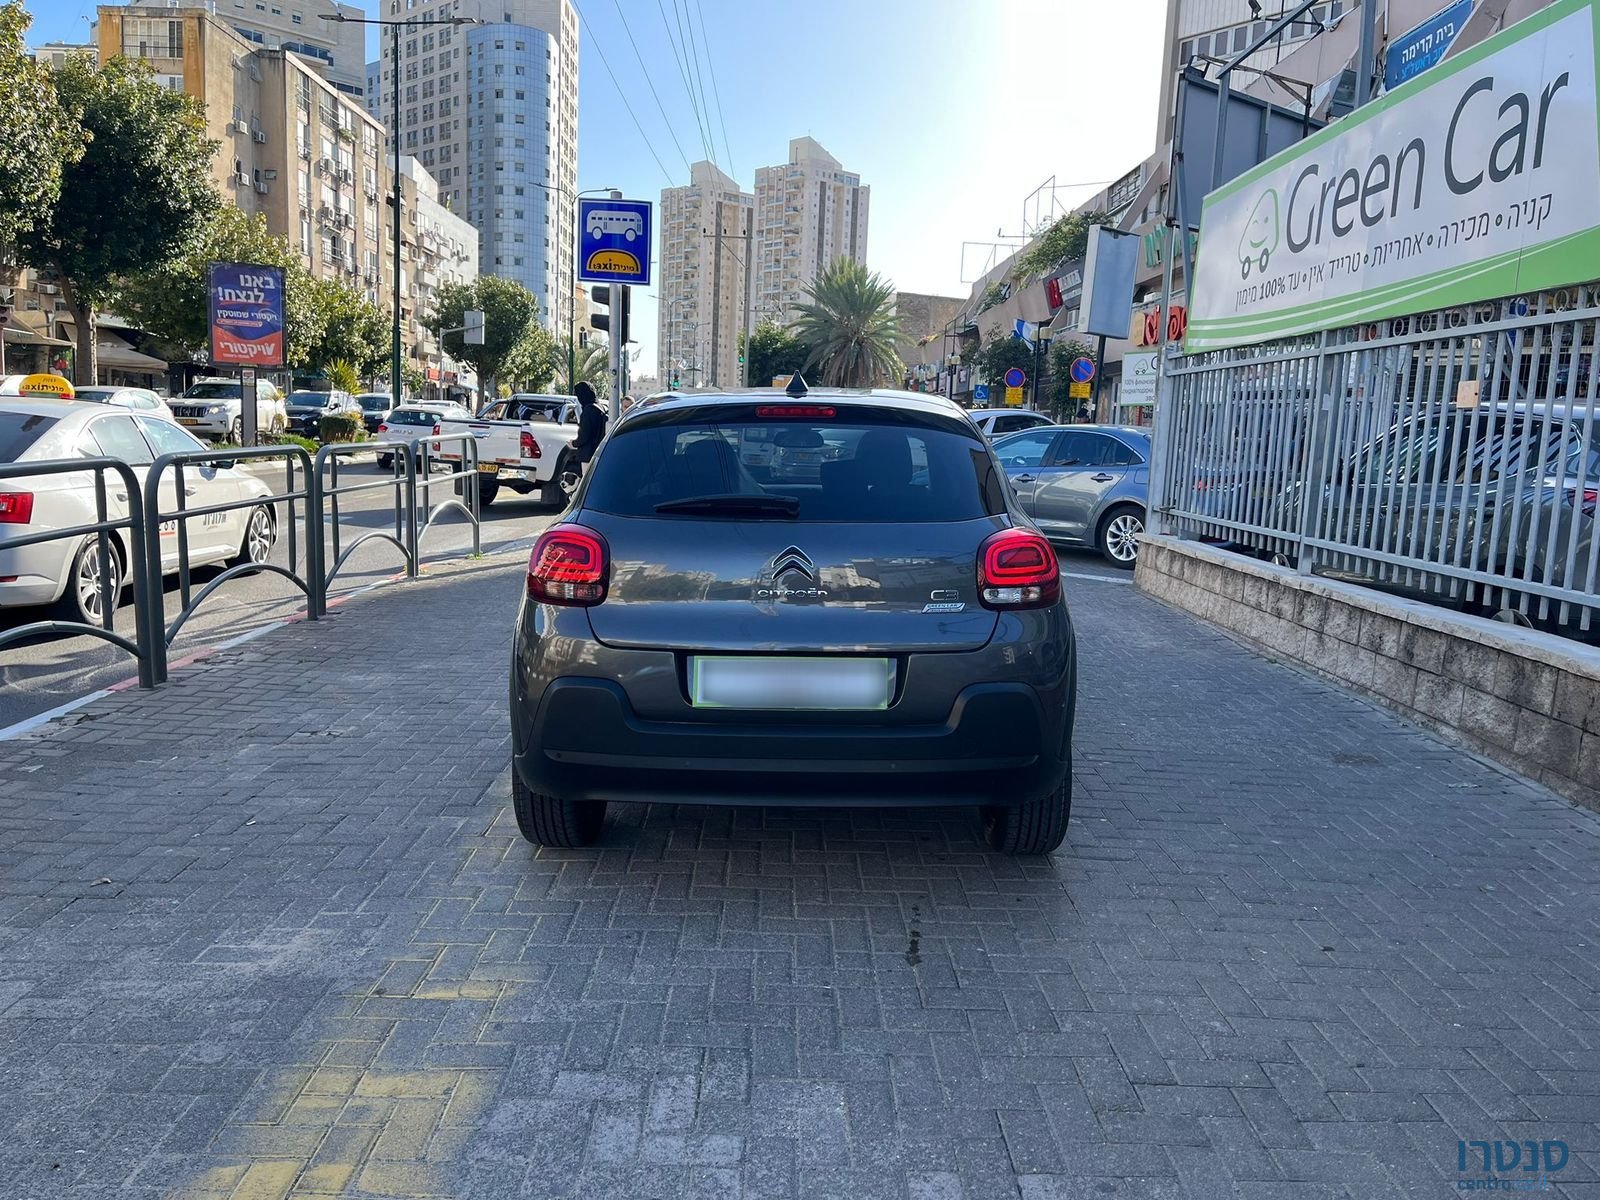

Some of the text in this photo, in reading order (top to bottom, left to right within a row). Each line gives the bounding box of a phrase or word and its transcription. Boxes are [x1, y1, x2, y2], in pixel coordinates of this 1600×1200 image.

[1401, 22, 1455, 64] בית קדימה
[1286, 71, 1569, 254] Green Car
[1235, 193, 1553, 312] קניה מכירה אחריות טרייד אין עד 100% מימון
[240, 274, 275, 289] באנו
[218, 286, 264, 303] לנצח!
[757, 587, 828, 598] CITROËN
[930, 589, 959, 601] C3
